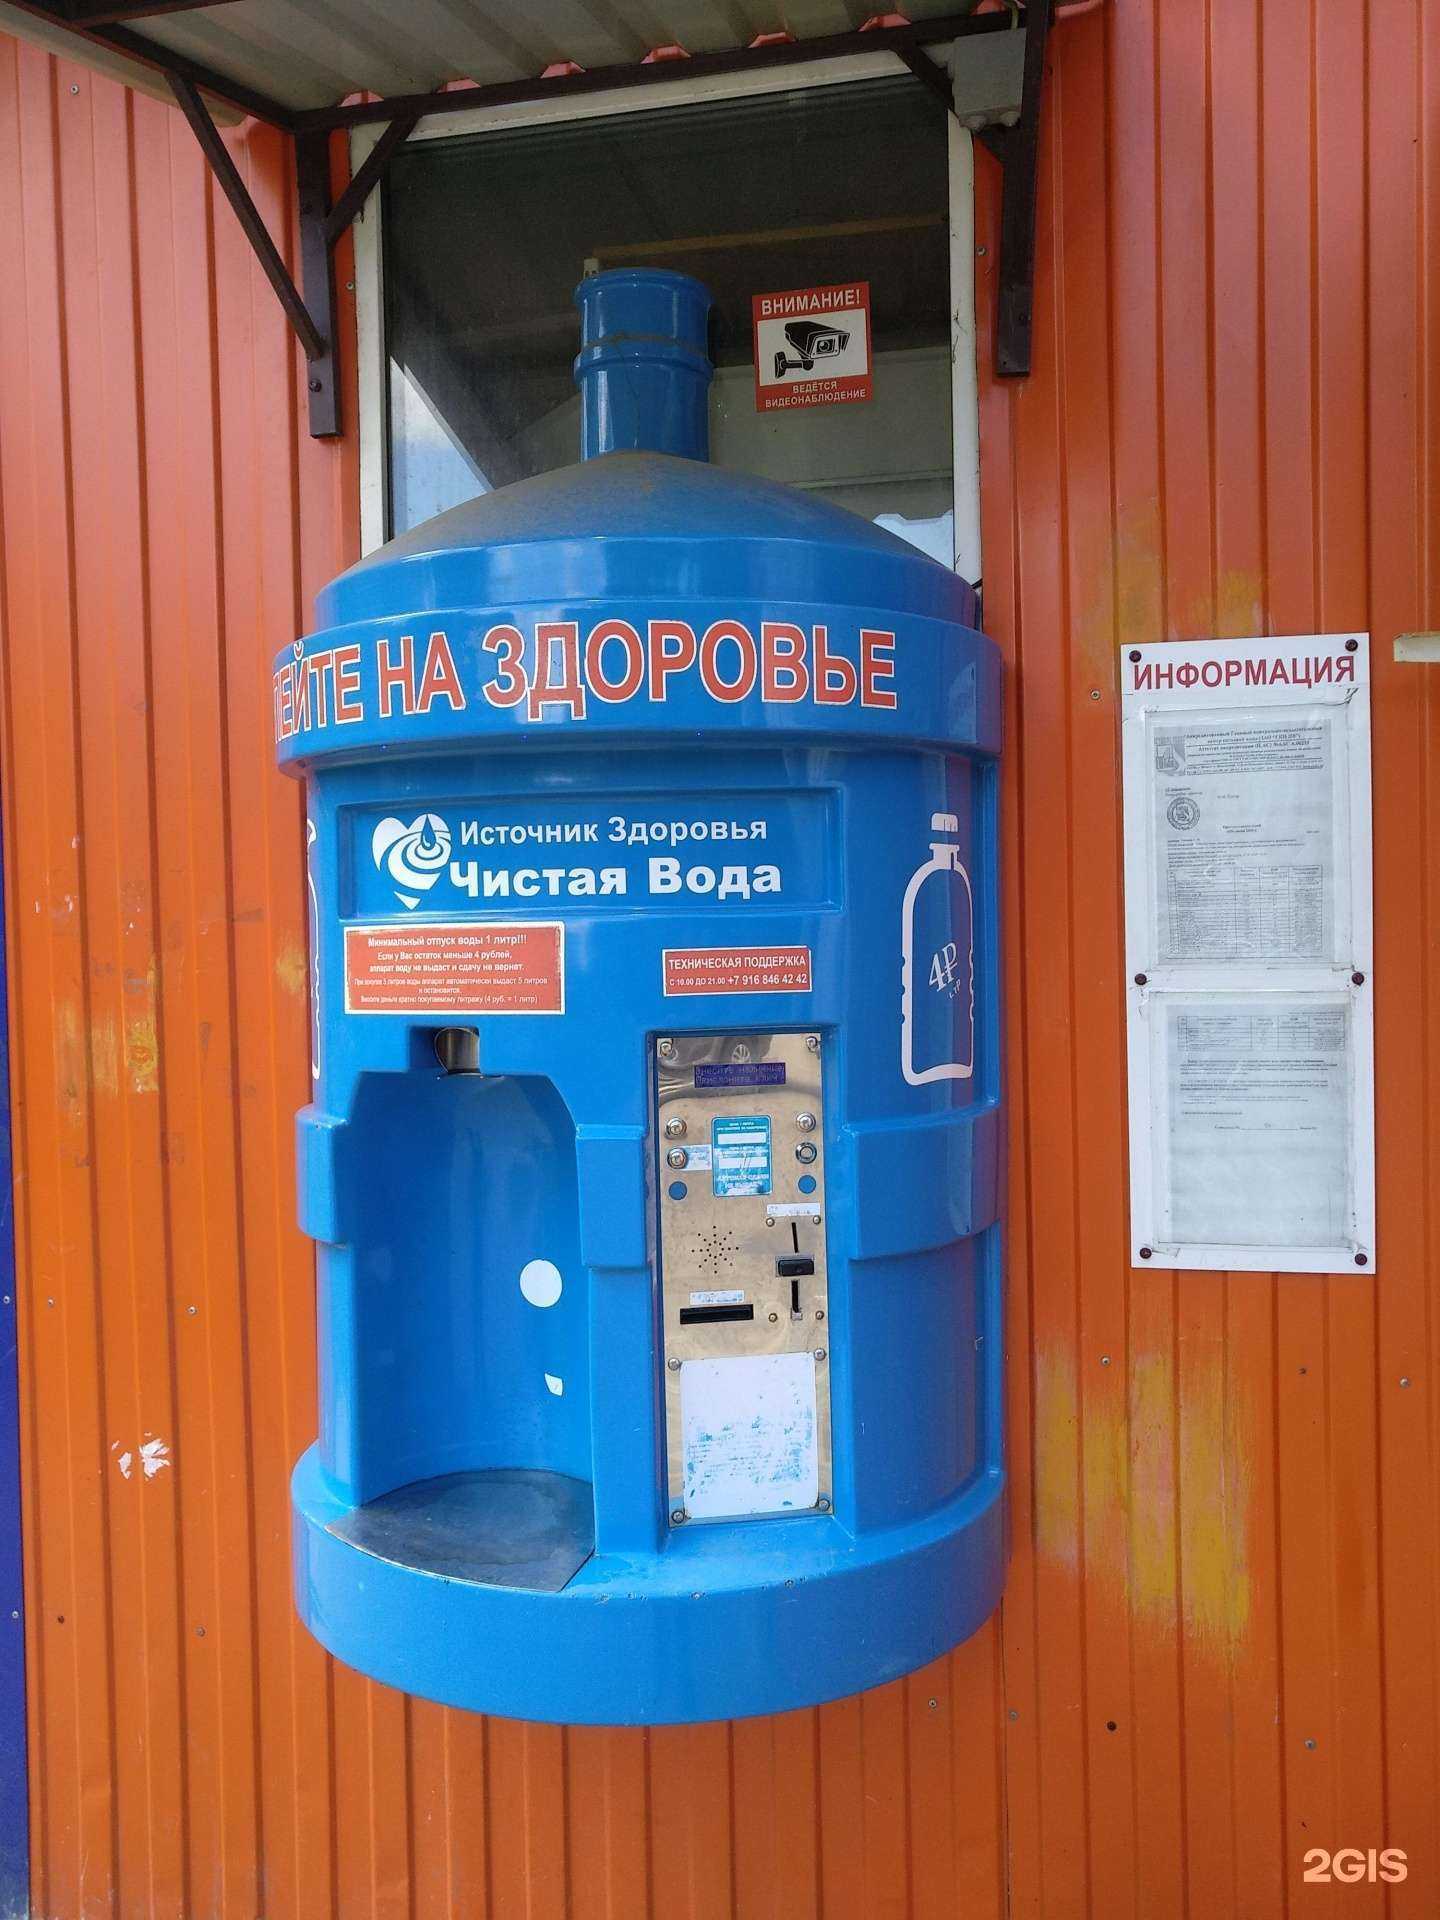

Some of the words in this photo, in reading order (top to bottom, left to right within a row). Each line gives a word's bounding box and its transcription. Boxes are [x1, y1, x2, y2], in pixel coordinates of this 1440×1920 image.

[762, 289, 860, 315] ВНИМАНИЕ!
[793, 380, 837, 394] ВЕДЁТСЯ
[765, 388, 866, 408] ВИДЕОНАБЛЮДЕНИЕ
[376, 631, 466, 719] НА
[482, 618, 898, 722] ЗДОРОВЬЕ
[1134, 656, 1354, 690] ИНФОРМАЦИЯ
[460, 820, 599, 846] Источник
[608, 816, 768, 847] Здоровья
[449, 861, 627, 898] Чистая
[648, 857, 781, 900] Вода
[368, 936, 424, 947] Минимальный
[427, 937, 455, 948] отпуск
[458, 936, 483, 946] воды
[486, 935, 491, 944] 1
[377, 952, 393, 960] Если
[400, 951, 413, 960] Вас
[414, 952, 441, 960] остаток
[444, 951, 473, 959] меньше
[474, 951, 479, 959] 4
[668, 957, 742, 970] ТЕХНИЧЕСКАЯ
[745, 955, 807, 969] ПОДДЕРЖКА
[423, 963, 450, 973] выдаст
[459, 963, 481, 973] сдачу
[677, 977, 694, 986] 10.00
[695, 977, 706, 986] ДО
[728, 975, 739, 985] +7
[743, 974, 760, 985] 916
[763, 974, 779, 985] 846
[782, 973, 793, 984] 42
[796, 973, 807, 984] 42
